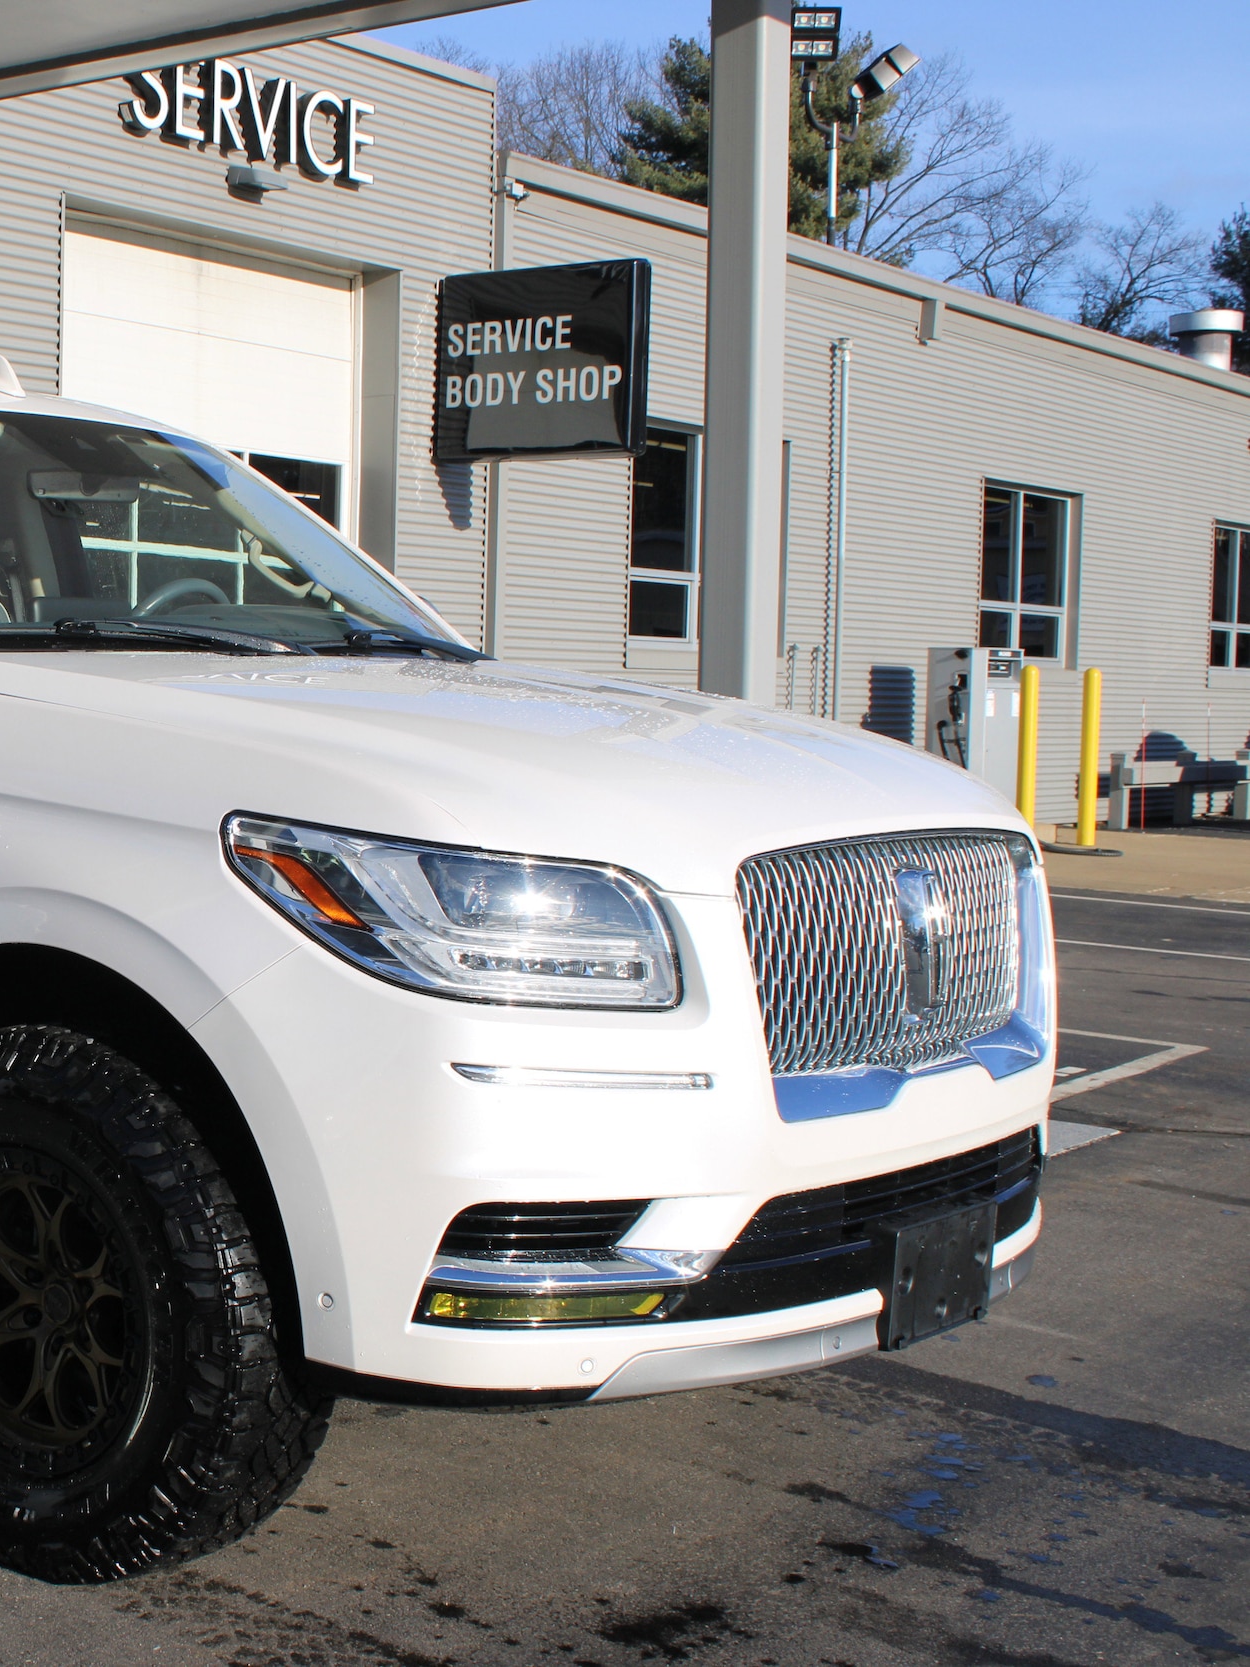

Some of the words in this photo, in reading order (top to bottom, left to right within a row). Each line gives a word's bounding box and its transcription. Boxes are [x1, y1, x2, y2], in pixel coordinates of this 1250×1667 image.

[130, 58, 376, 185] SERVICE
[447, 314, 573, 358] SERVICE
[445, 370, 526, 409] BODY
[535, 364, 623, 404] SHOP
